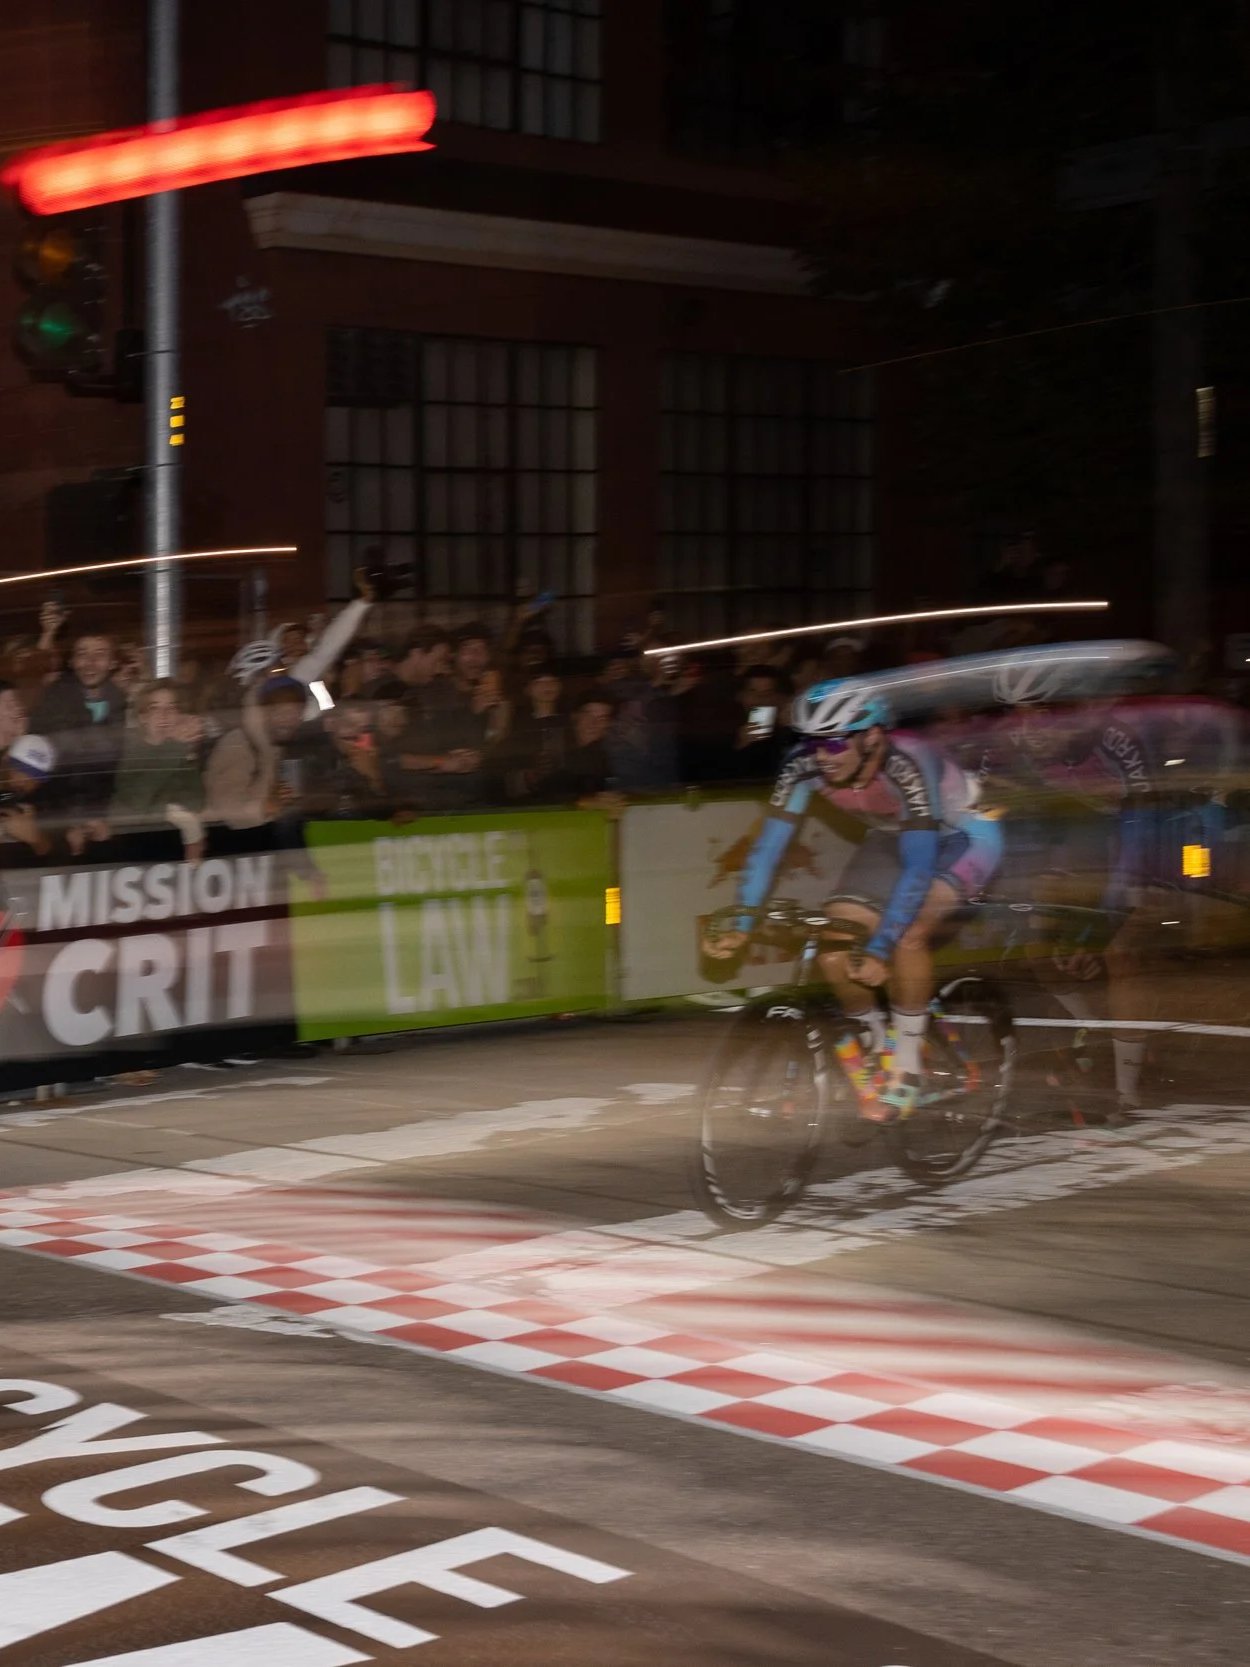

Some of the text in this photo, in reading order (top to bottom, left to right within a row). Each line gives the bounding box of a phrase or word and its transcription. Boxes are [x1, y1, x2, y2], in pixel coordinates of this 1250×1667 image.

[37, 856, 273, 931] MISSION
[43, 920, 268, 1046] CRIT
[378, 894, 513, 1015] LAW
